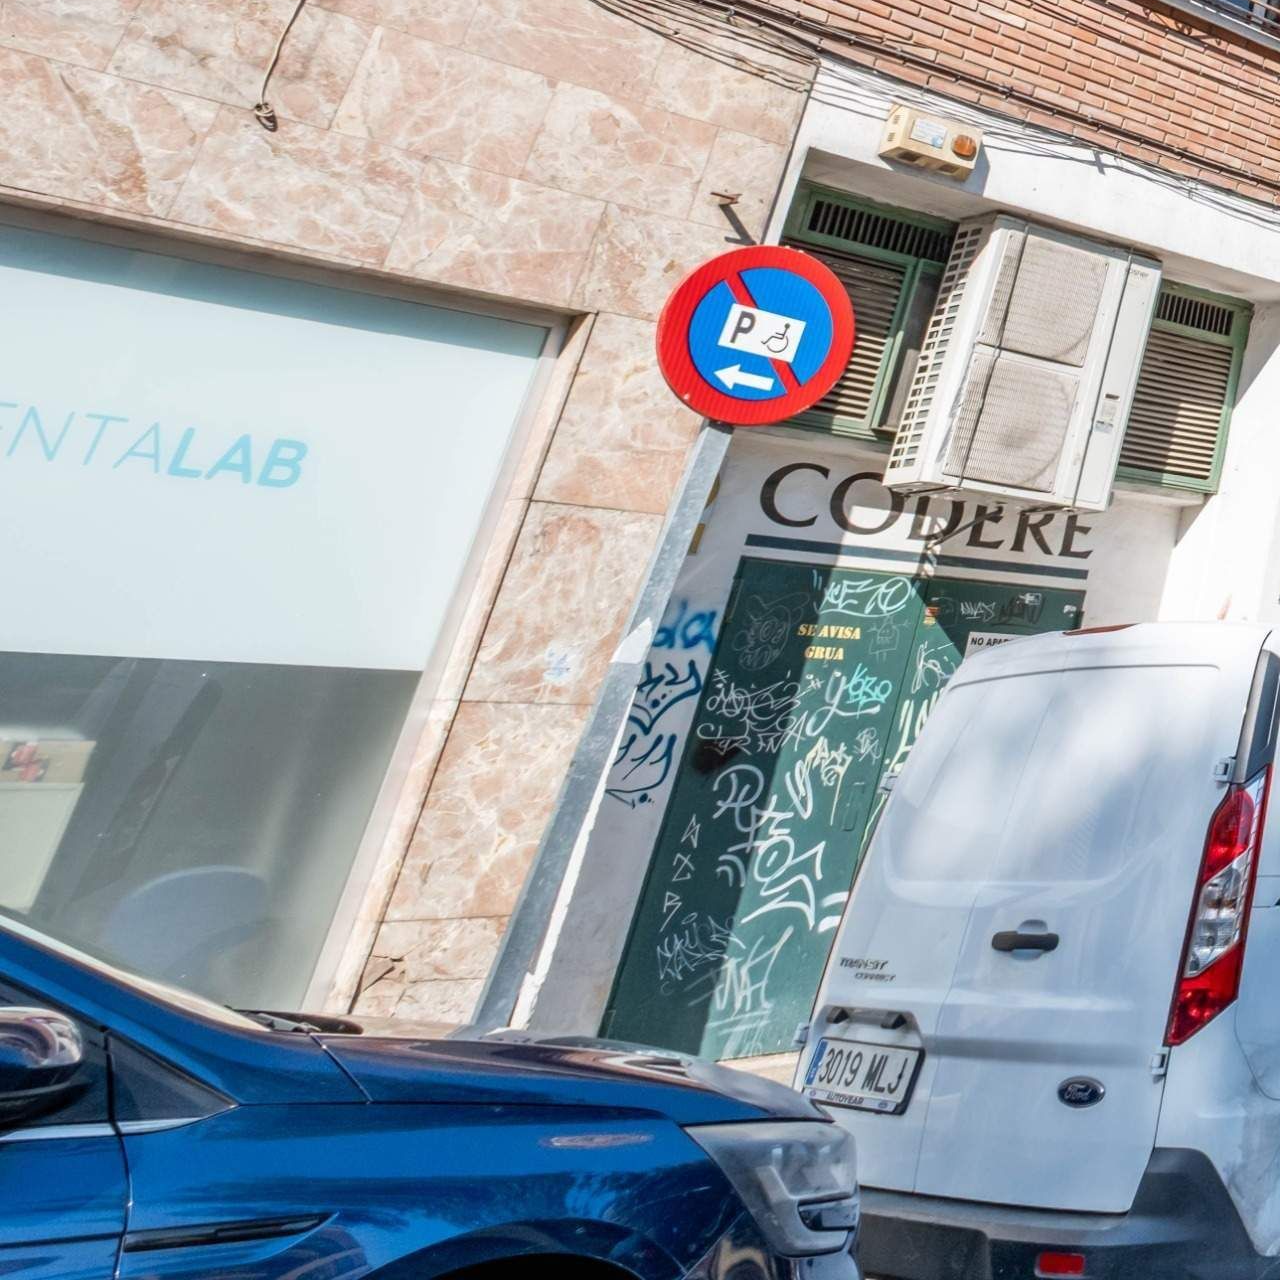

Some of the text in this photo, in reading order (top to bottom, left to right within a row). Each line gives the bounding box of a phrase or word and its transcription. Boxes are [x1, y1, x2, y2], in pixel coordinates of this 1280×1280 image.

[730, 310, 756, 344] P
[759, 462, 1093, 559] CODERE
[797, 623, 861, 640] SE AVISA
[970, 636, 984, 647] NO
[804, 646, 844, 661] GRUA
[818, 1047, 909, 1095] 3019 MLJ
